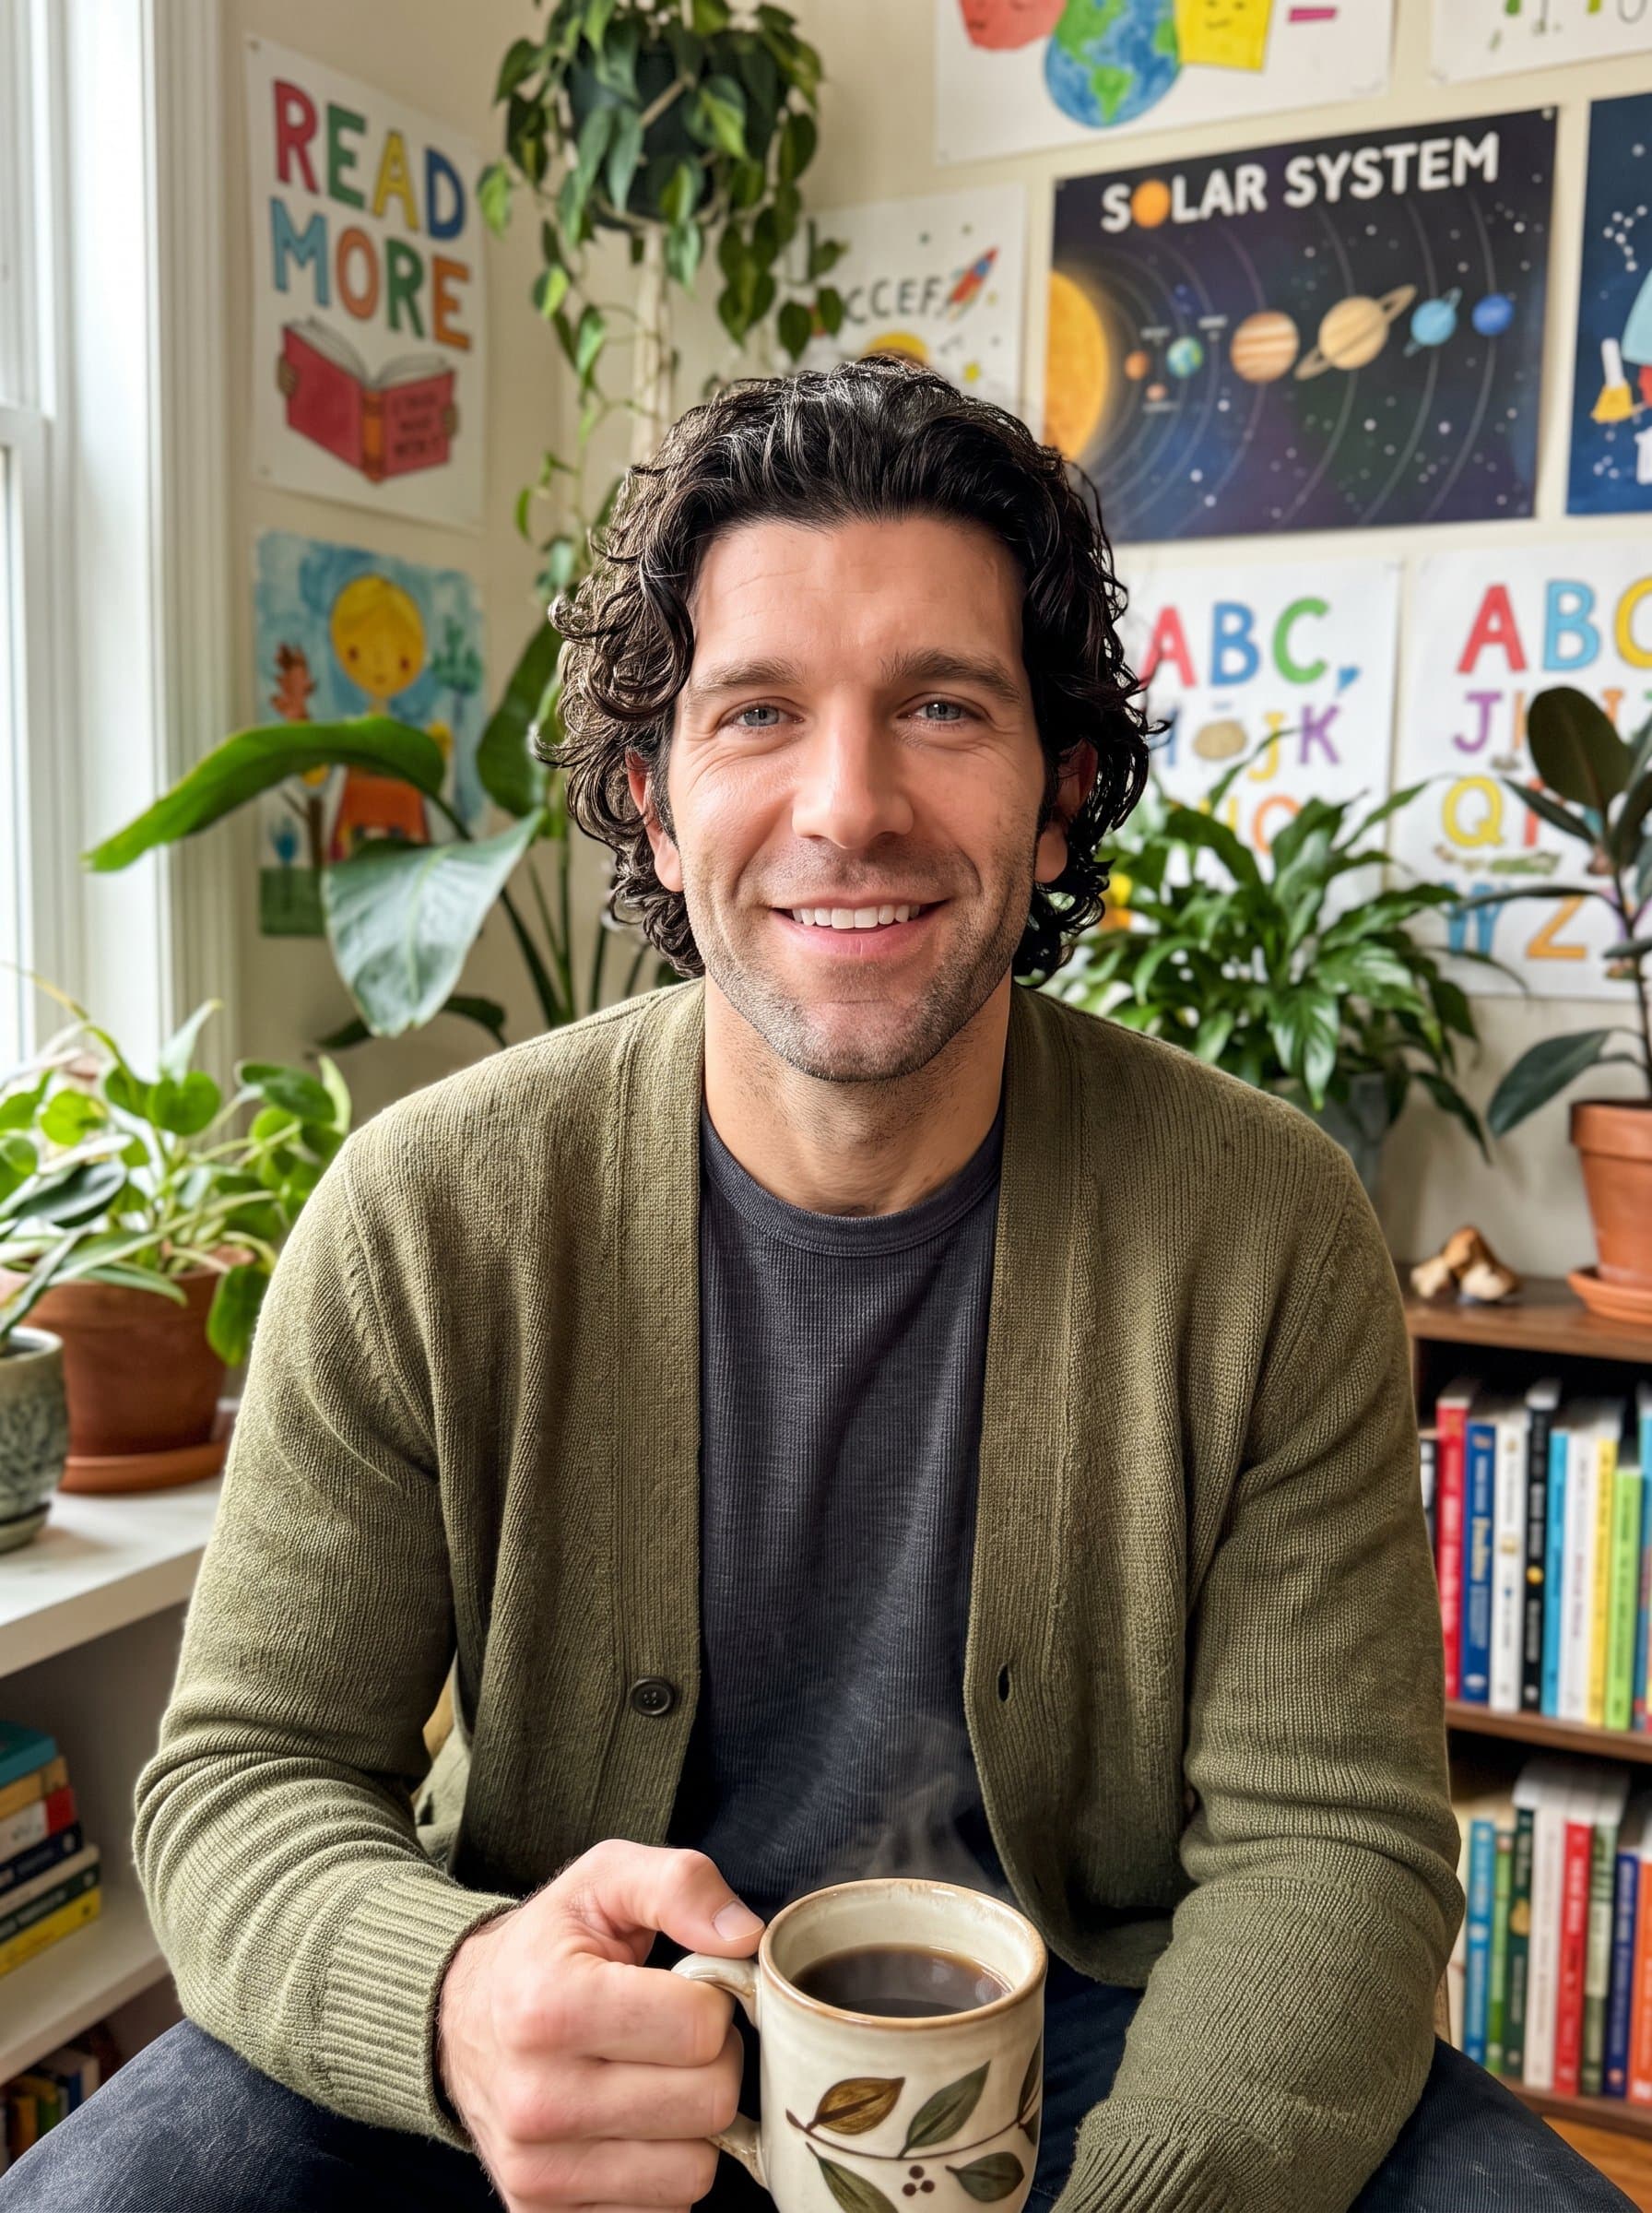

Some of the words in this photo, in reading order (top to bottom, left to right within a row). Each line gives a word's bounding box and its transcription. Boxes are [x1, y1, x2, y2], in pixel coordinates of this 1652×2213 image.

[272, 77, 466, 241] READ
[1283, 131, 1500, 208] SYSTEM
[269, 195, 472, 351] MORE
